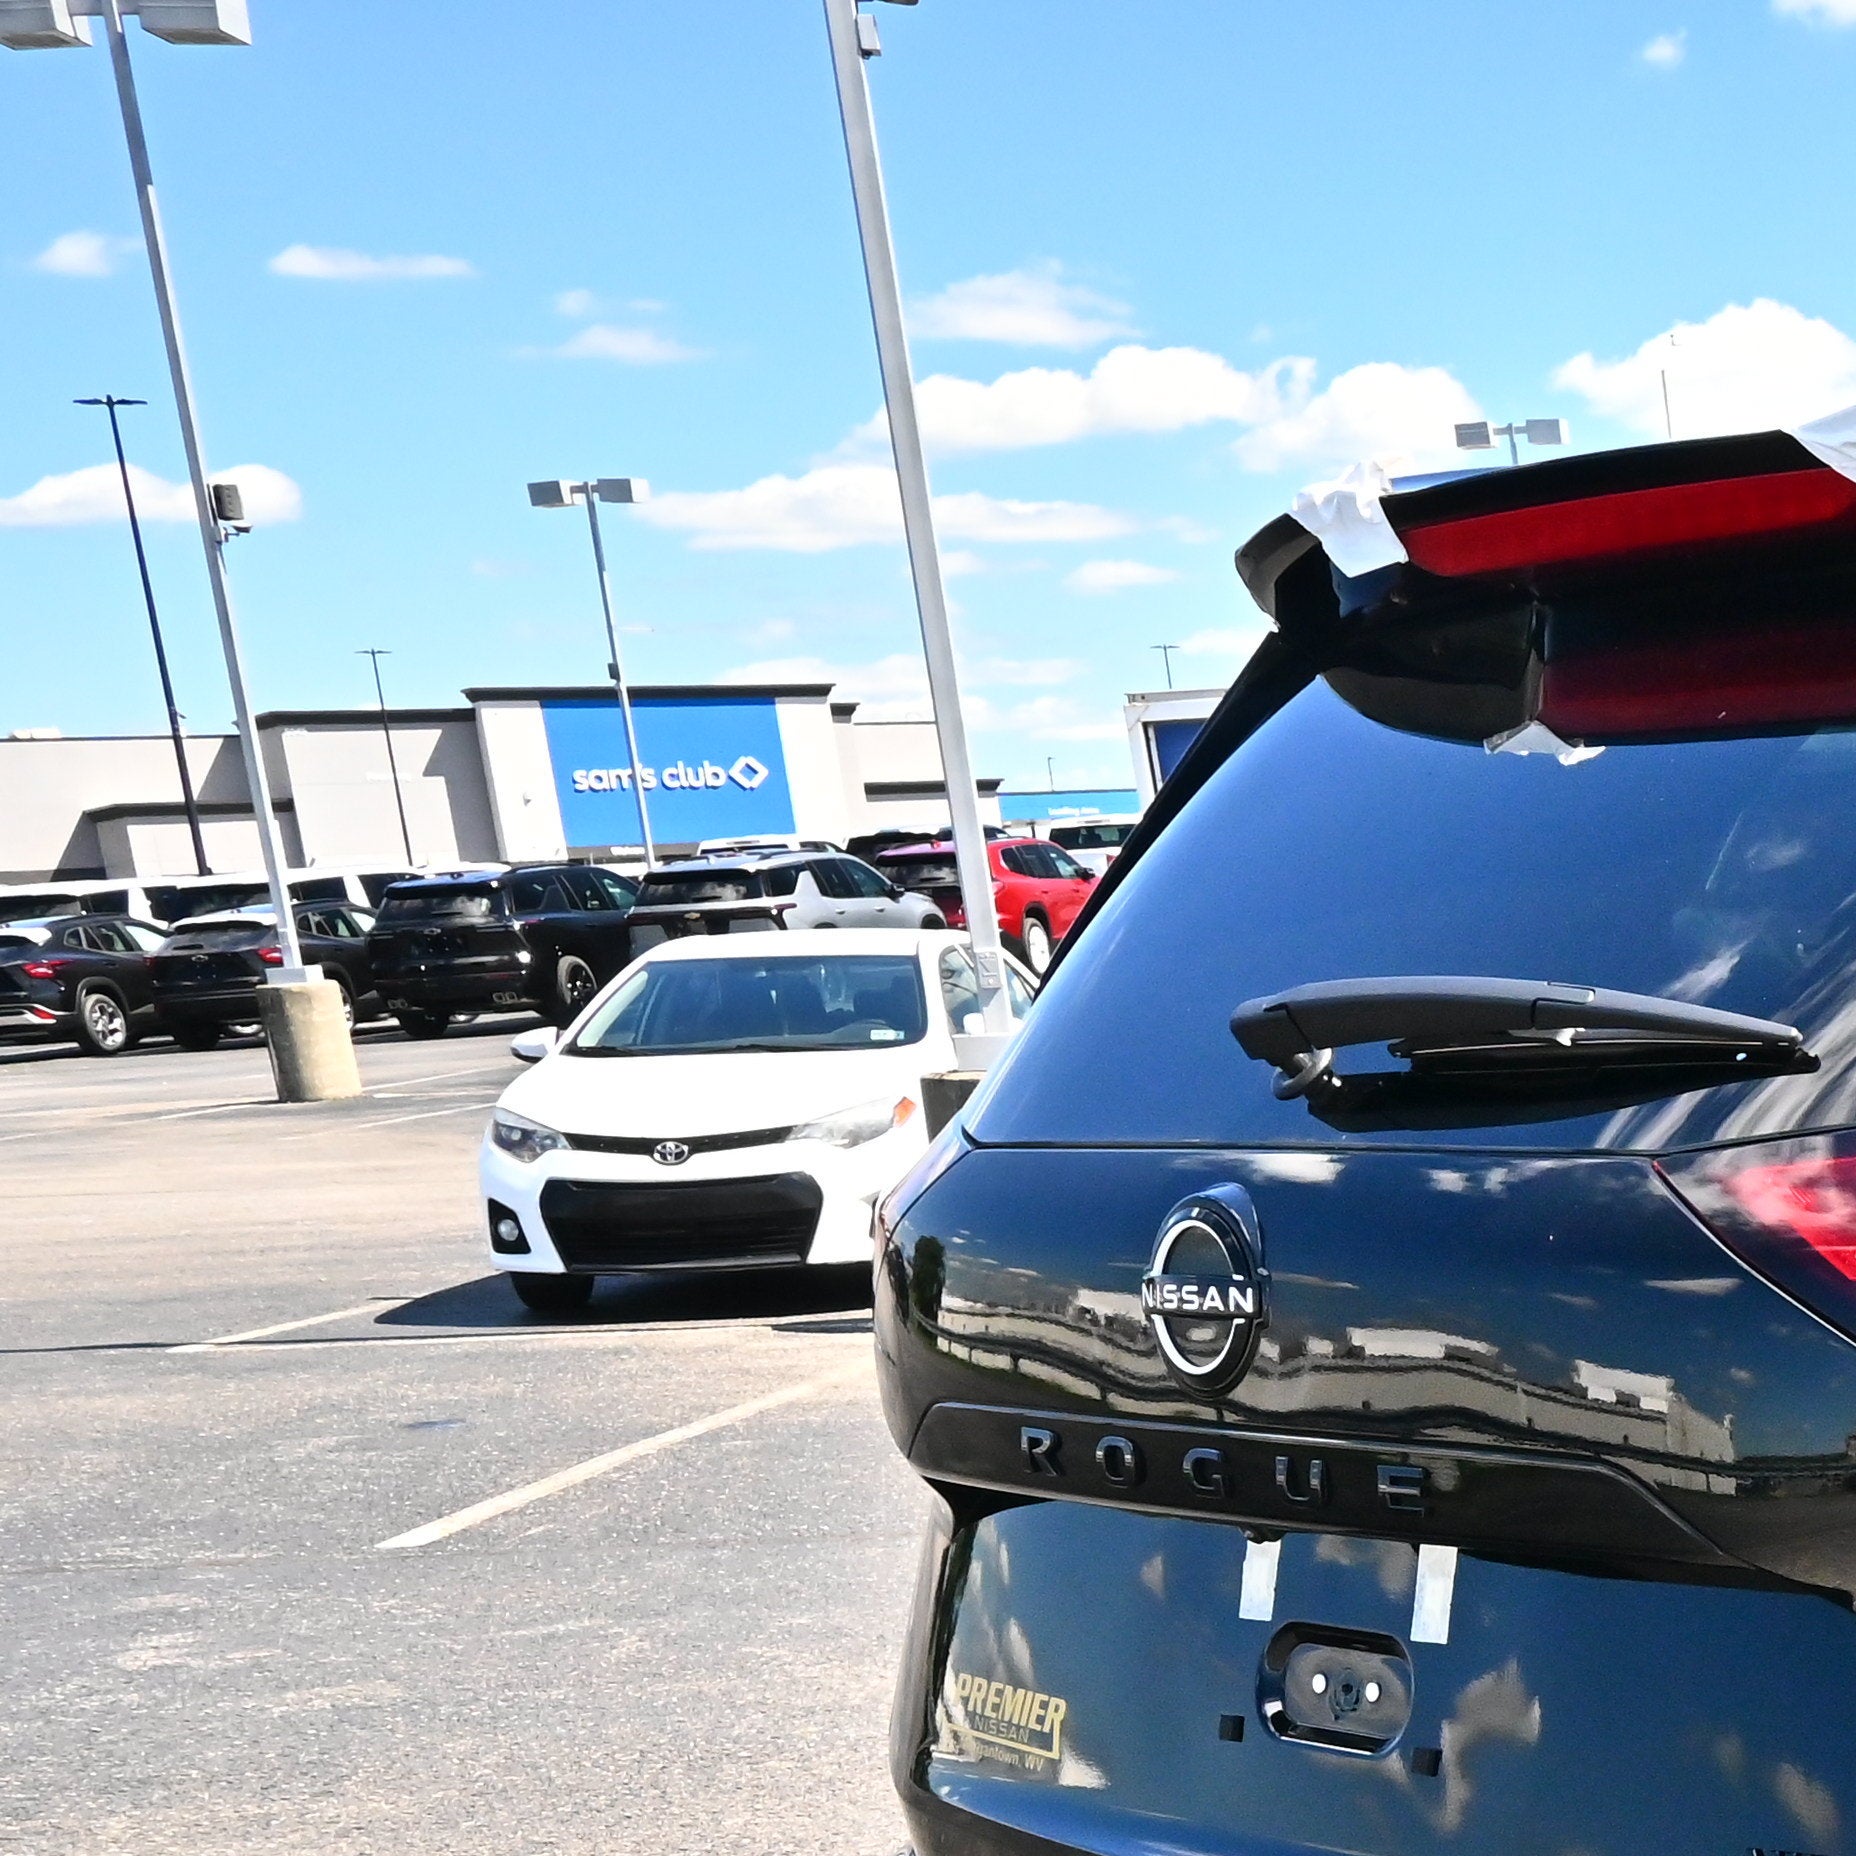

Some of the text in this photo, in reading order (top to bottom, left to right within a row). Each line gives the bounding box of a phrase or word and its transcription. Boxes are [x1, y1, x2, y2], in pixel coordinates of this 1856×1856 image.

[662, 760, 727, 790] club
[1141, 1283, 1254, 1313] NISSAN
[1020, 1426, 1426, 1517] ROGUE
[958, 1672, 1067, 1734] PREMIER
[973, 1715, 1030, 1743] NISSAN
[1022, 1753, 1045, 1772] WV
